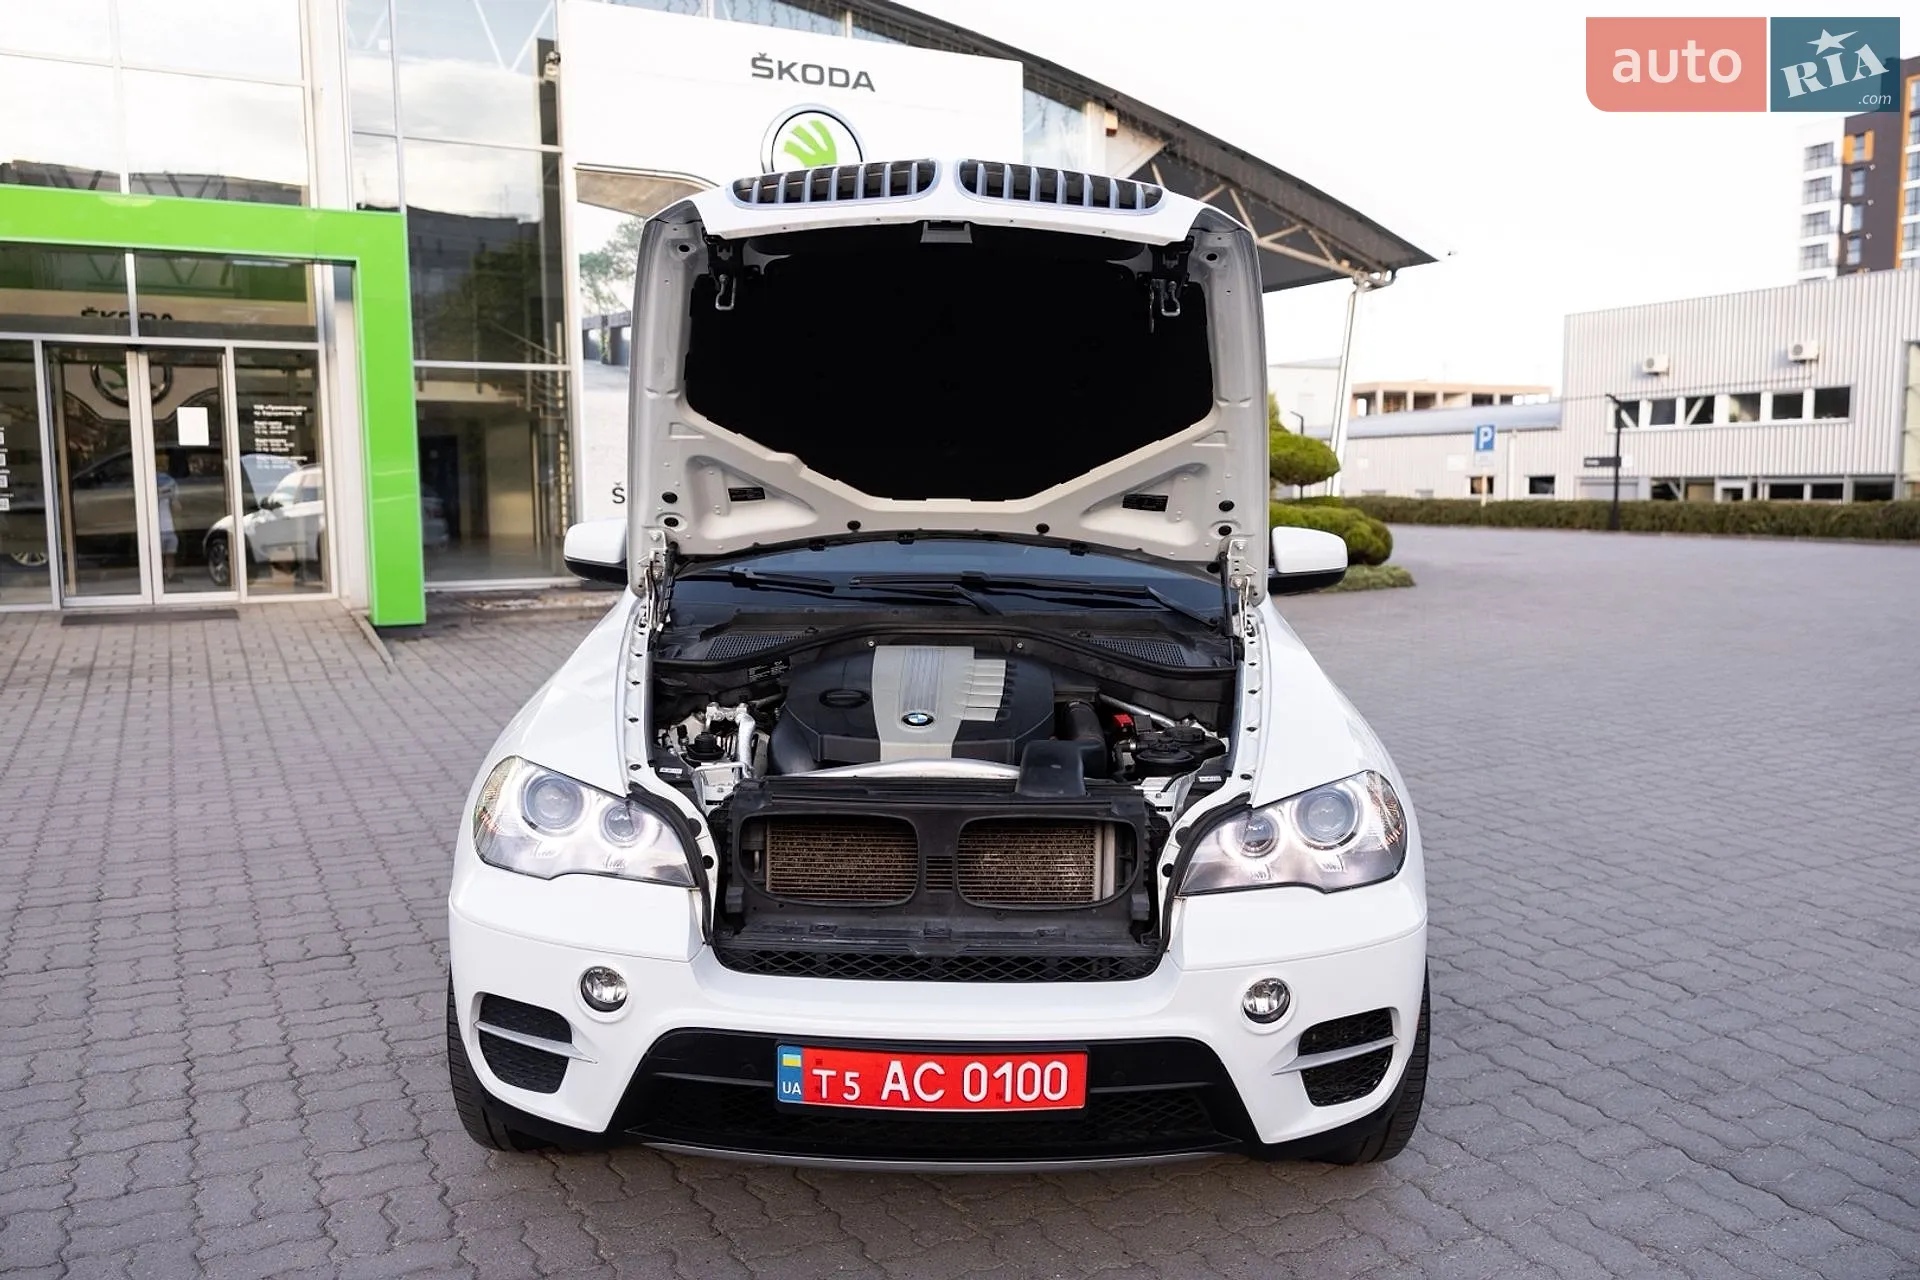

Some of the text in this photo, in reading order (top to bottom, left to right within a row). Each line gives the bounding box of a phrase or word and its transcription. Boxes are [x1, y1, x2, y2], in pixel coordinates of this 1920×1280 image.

[751, 51, 876, 93] ŠKODA
[1479, 425, 1494, 450] P
[782, 1081, 802, 1096] UA
[880, 1060, 945, 1103] AC
[963, 1060, 1069, 1103] 0100
